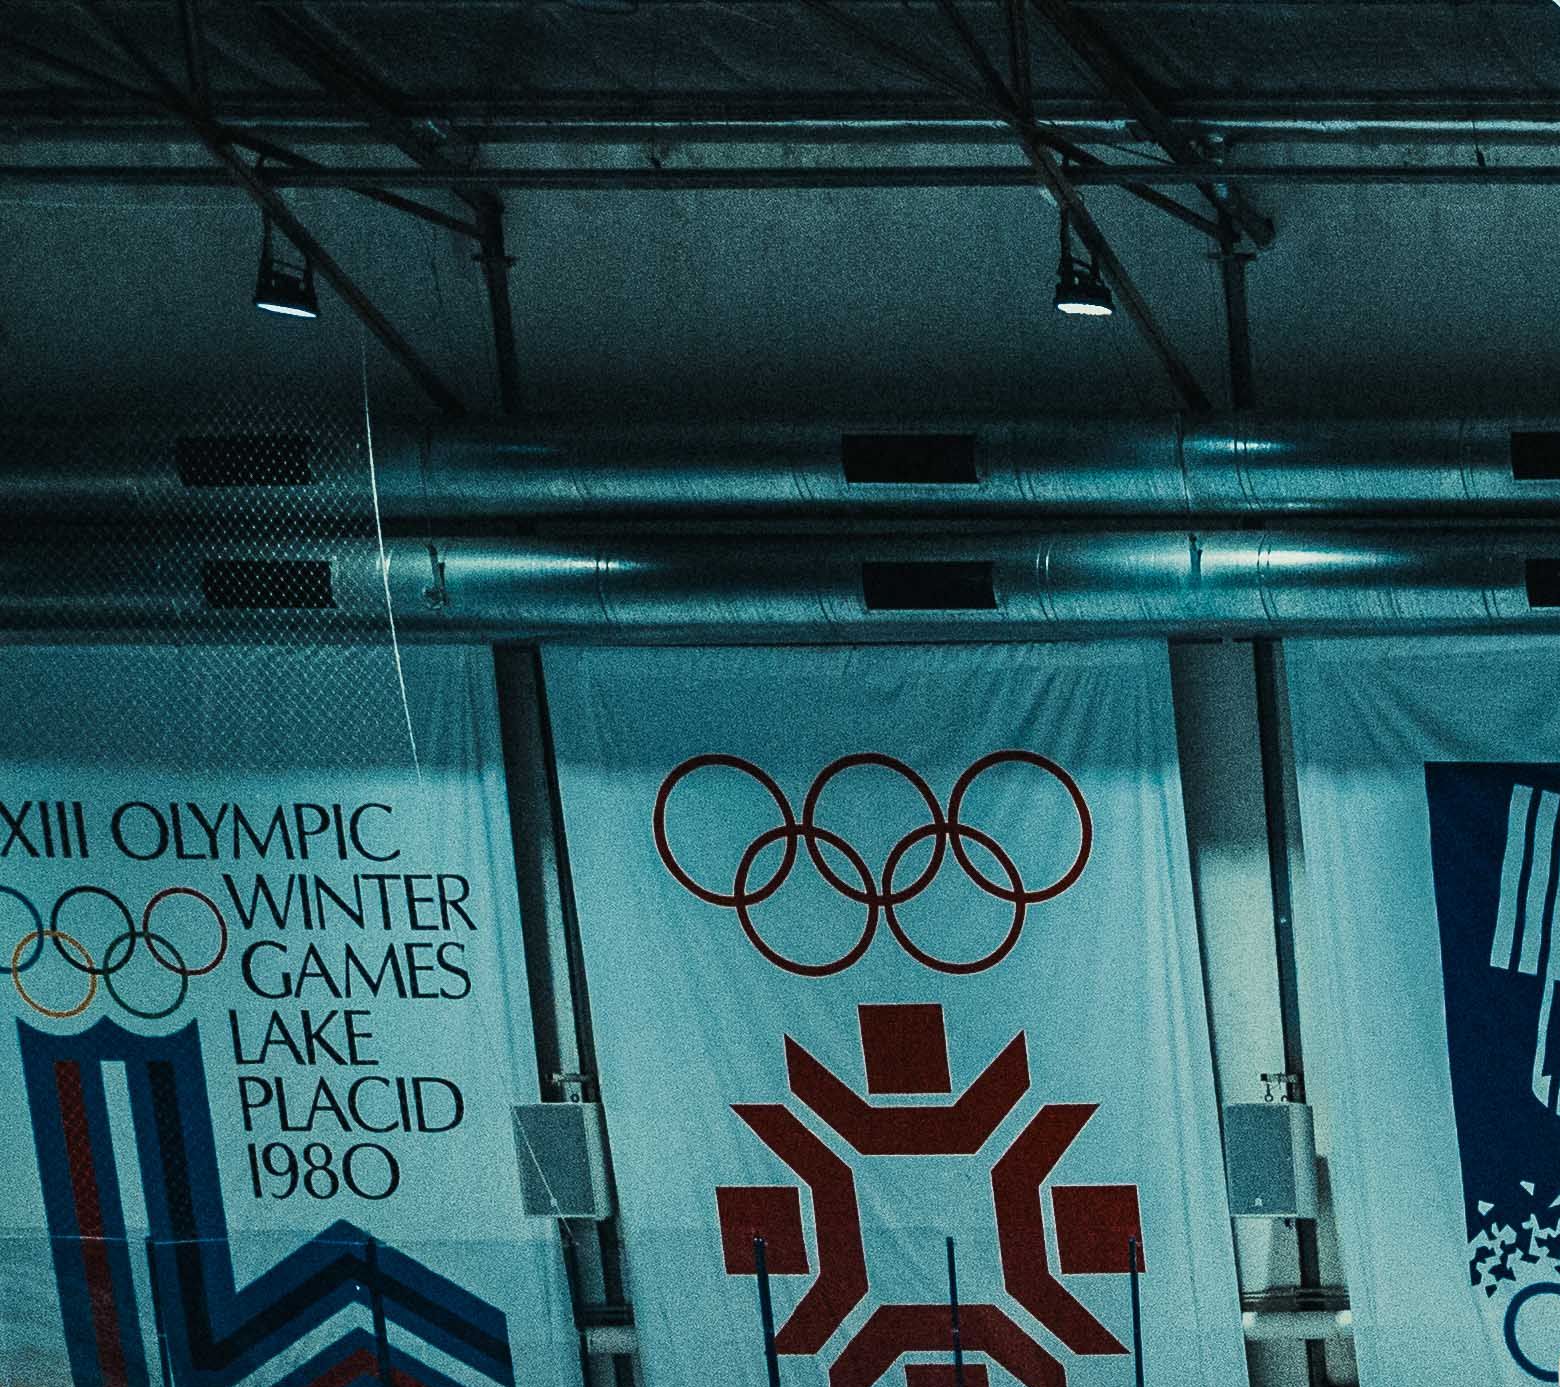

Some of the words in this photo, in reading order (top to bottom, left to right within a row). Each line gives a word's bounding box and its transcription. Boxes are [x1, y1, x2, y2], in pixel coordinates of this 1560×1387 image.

[0, 801, 87, 858] XIII
[111, 802, 401, 861] OLYMPIC
[224, 874, 478, 931] WINTER
[241, 941, 472, 1000] GAMES
[229, 1009, 380, 1066] LAKE
[238, 1076, 464, 1133] PLACID
[248, 1143, 401, 1200] 1980
